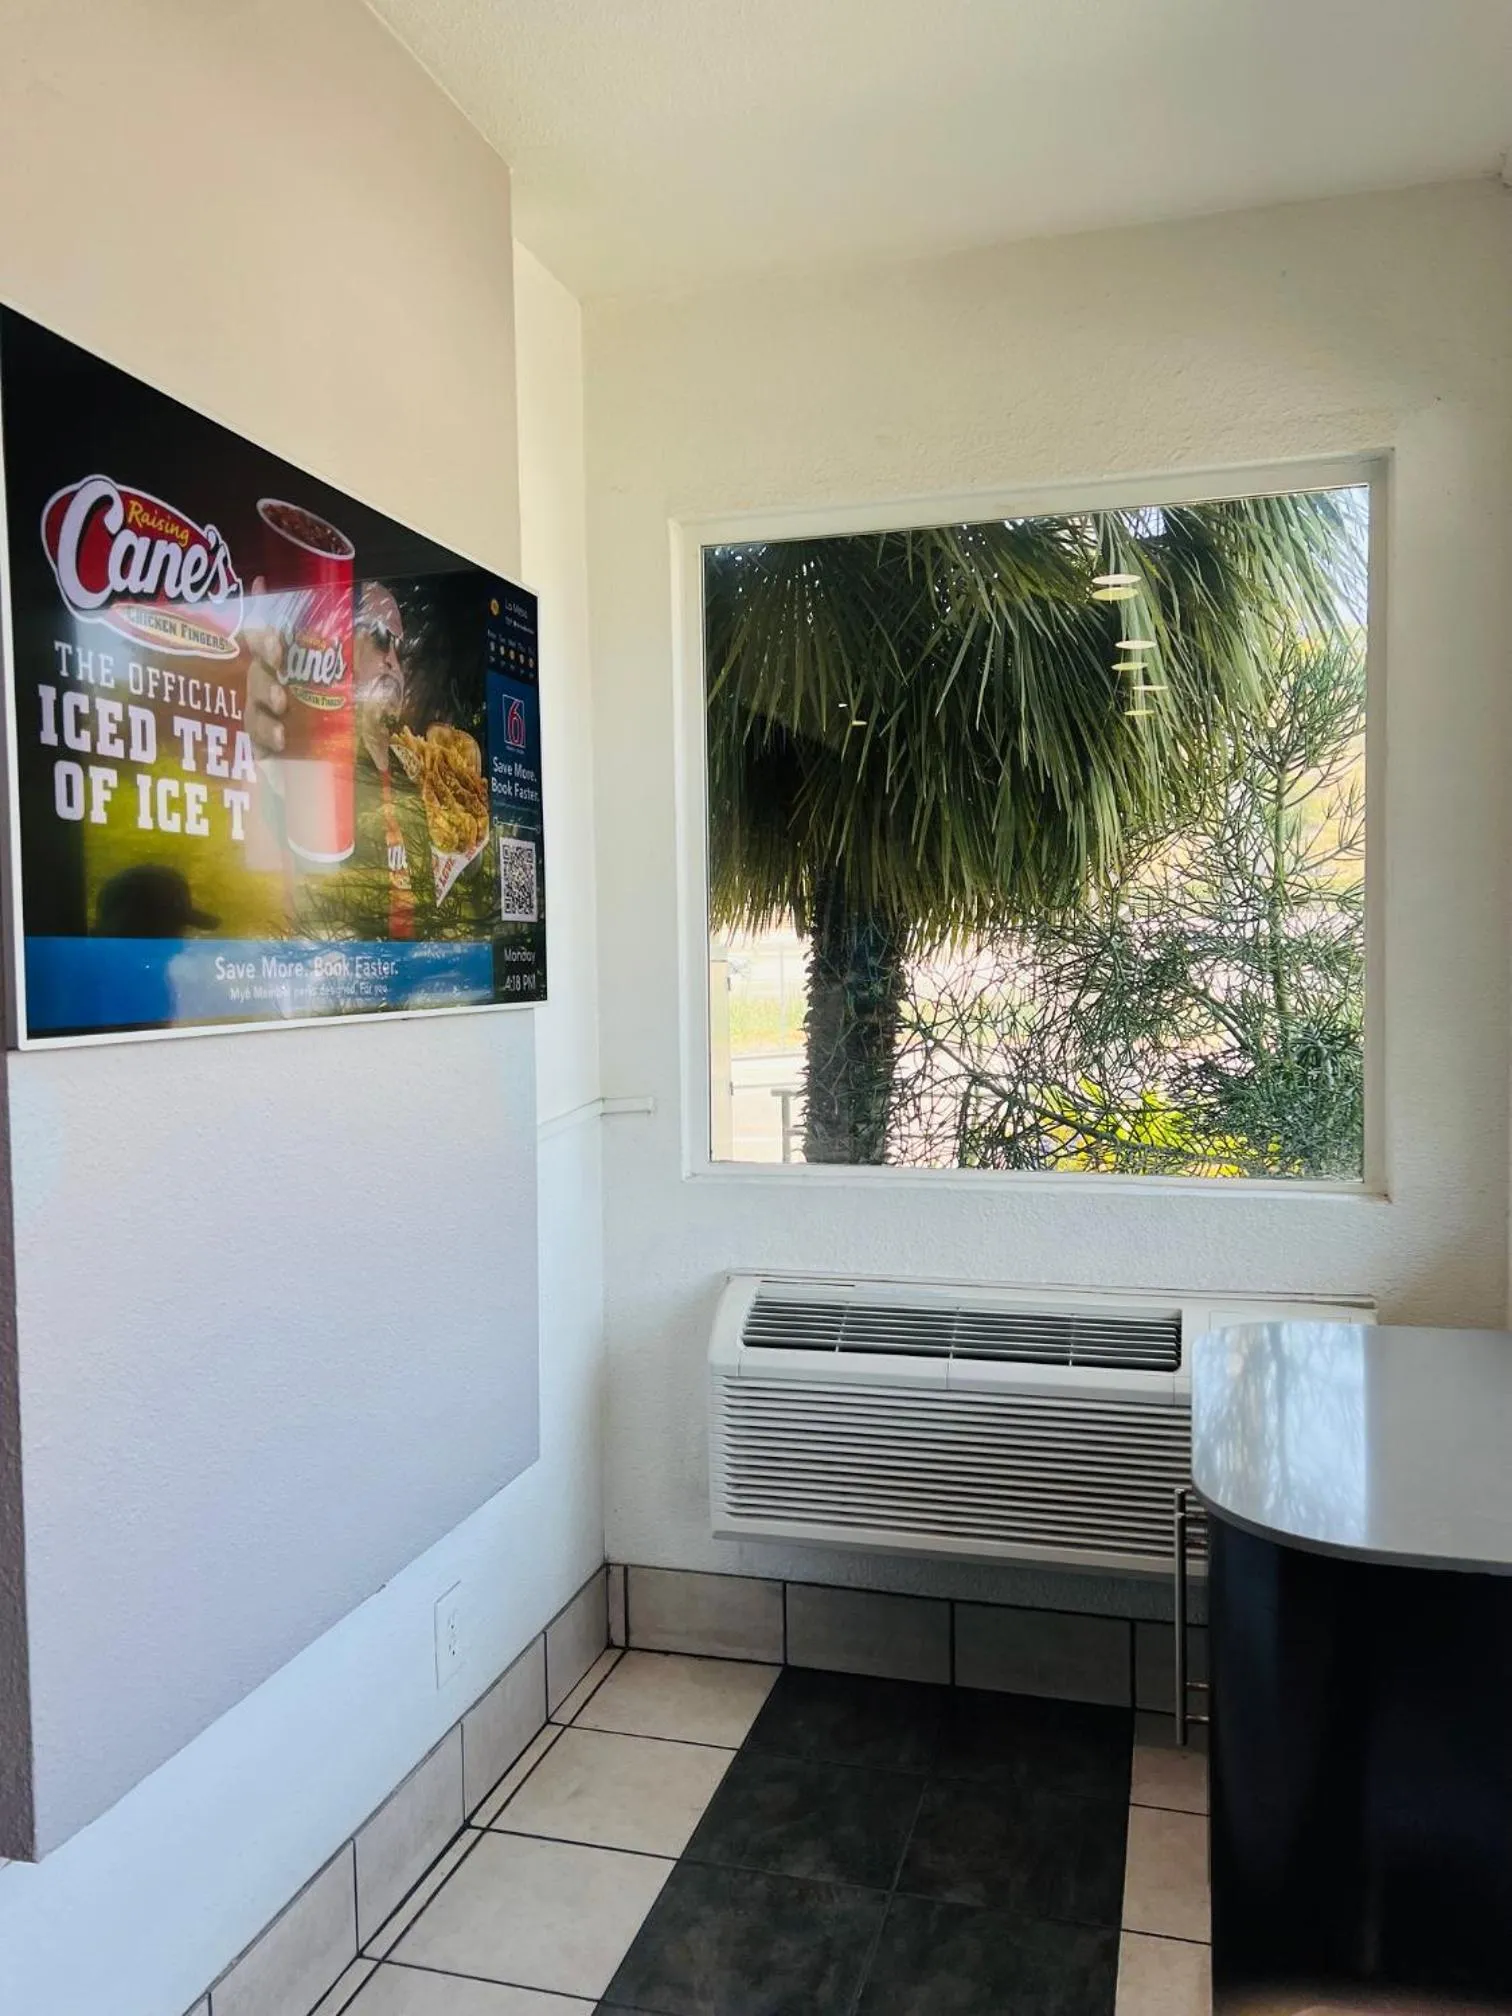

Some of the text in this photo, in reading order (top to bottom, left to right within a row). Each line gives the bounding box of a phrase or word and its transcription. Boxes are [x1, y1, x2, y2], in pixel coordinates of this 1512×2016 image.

[57, 480, 239, 609] Cane's
[127, 500, 190, 547] Raising
[124, 604, 226, 651] CHICKEN FINGERS
[55, 641, 243, 720] THE OFFICIAL
[38, 684, 257, 782] ICED TEA
[491, 776, 513, 797] Book
[492, 756, 513, 777] Save
[54, 759, 250, 840] OF ICE T
[215, 956, 256, 981] Save
[314, 956, 349, 977] Book
[504, 948, 536, 965] Monday
